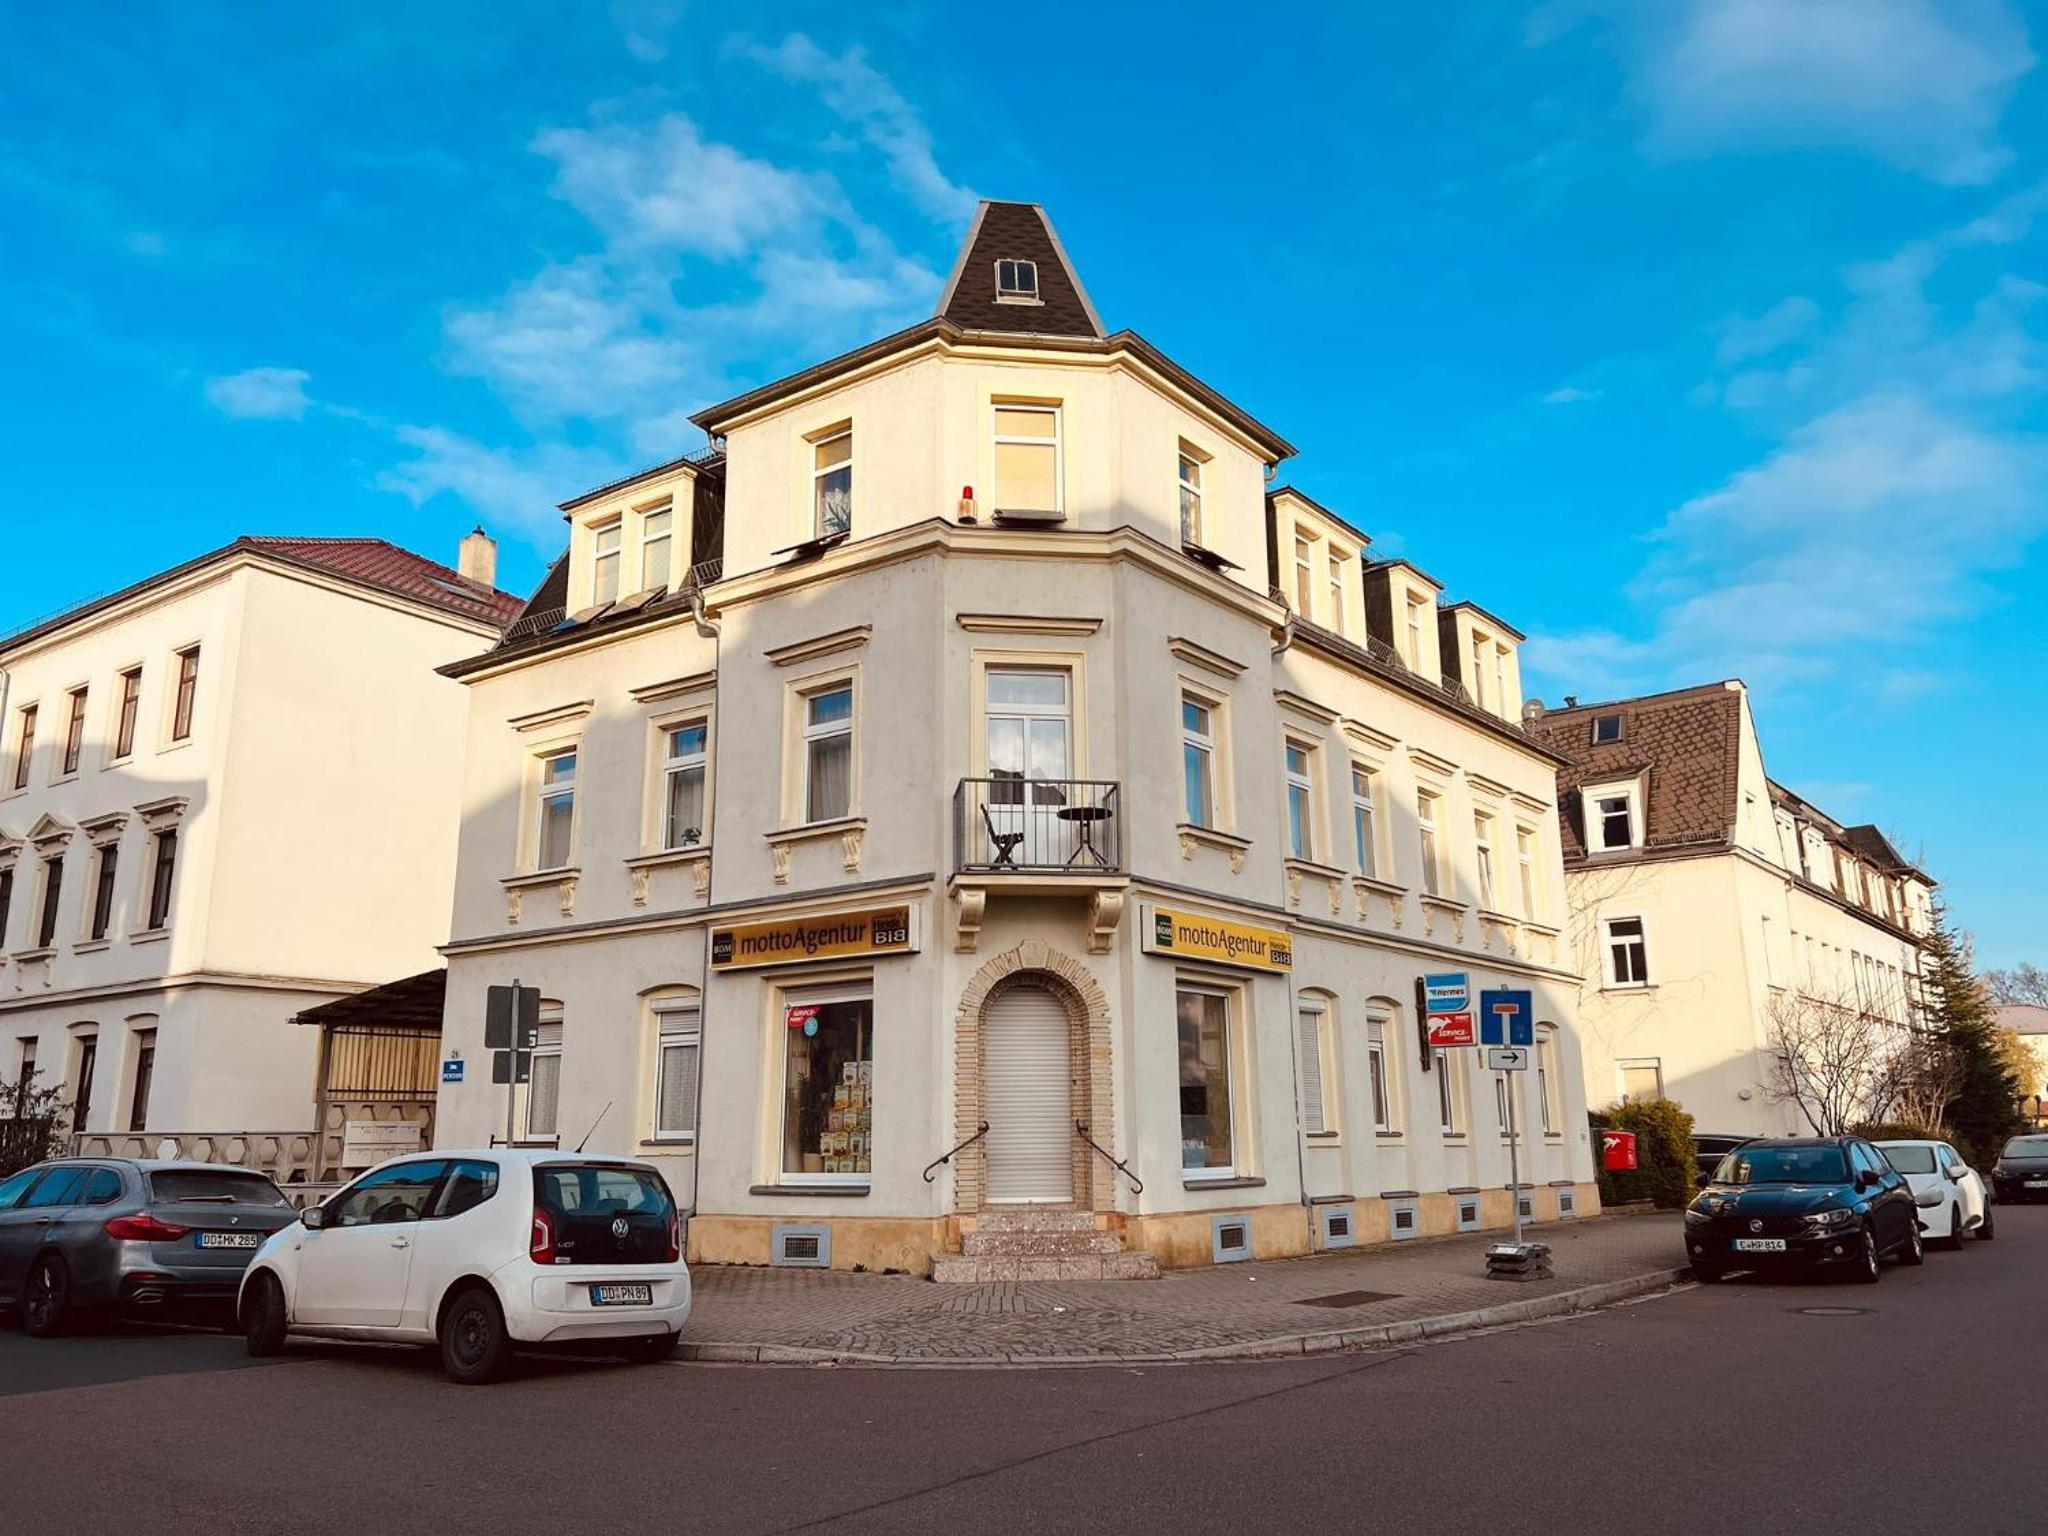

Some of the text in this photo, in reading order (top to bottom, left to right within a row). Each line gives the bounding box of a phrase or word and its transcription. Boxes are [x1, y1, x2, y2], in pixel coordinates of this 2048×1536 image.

[741, 924, 867, 954] mottoAgentur
[1179, 926, 1267, 957] mottoAgentur
[1437, 988, 1464, 996] Hermes
[204, 1235, 217, 1245] DD
[601, 1286, 647, 1300] DD PN 89
